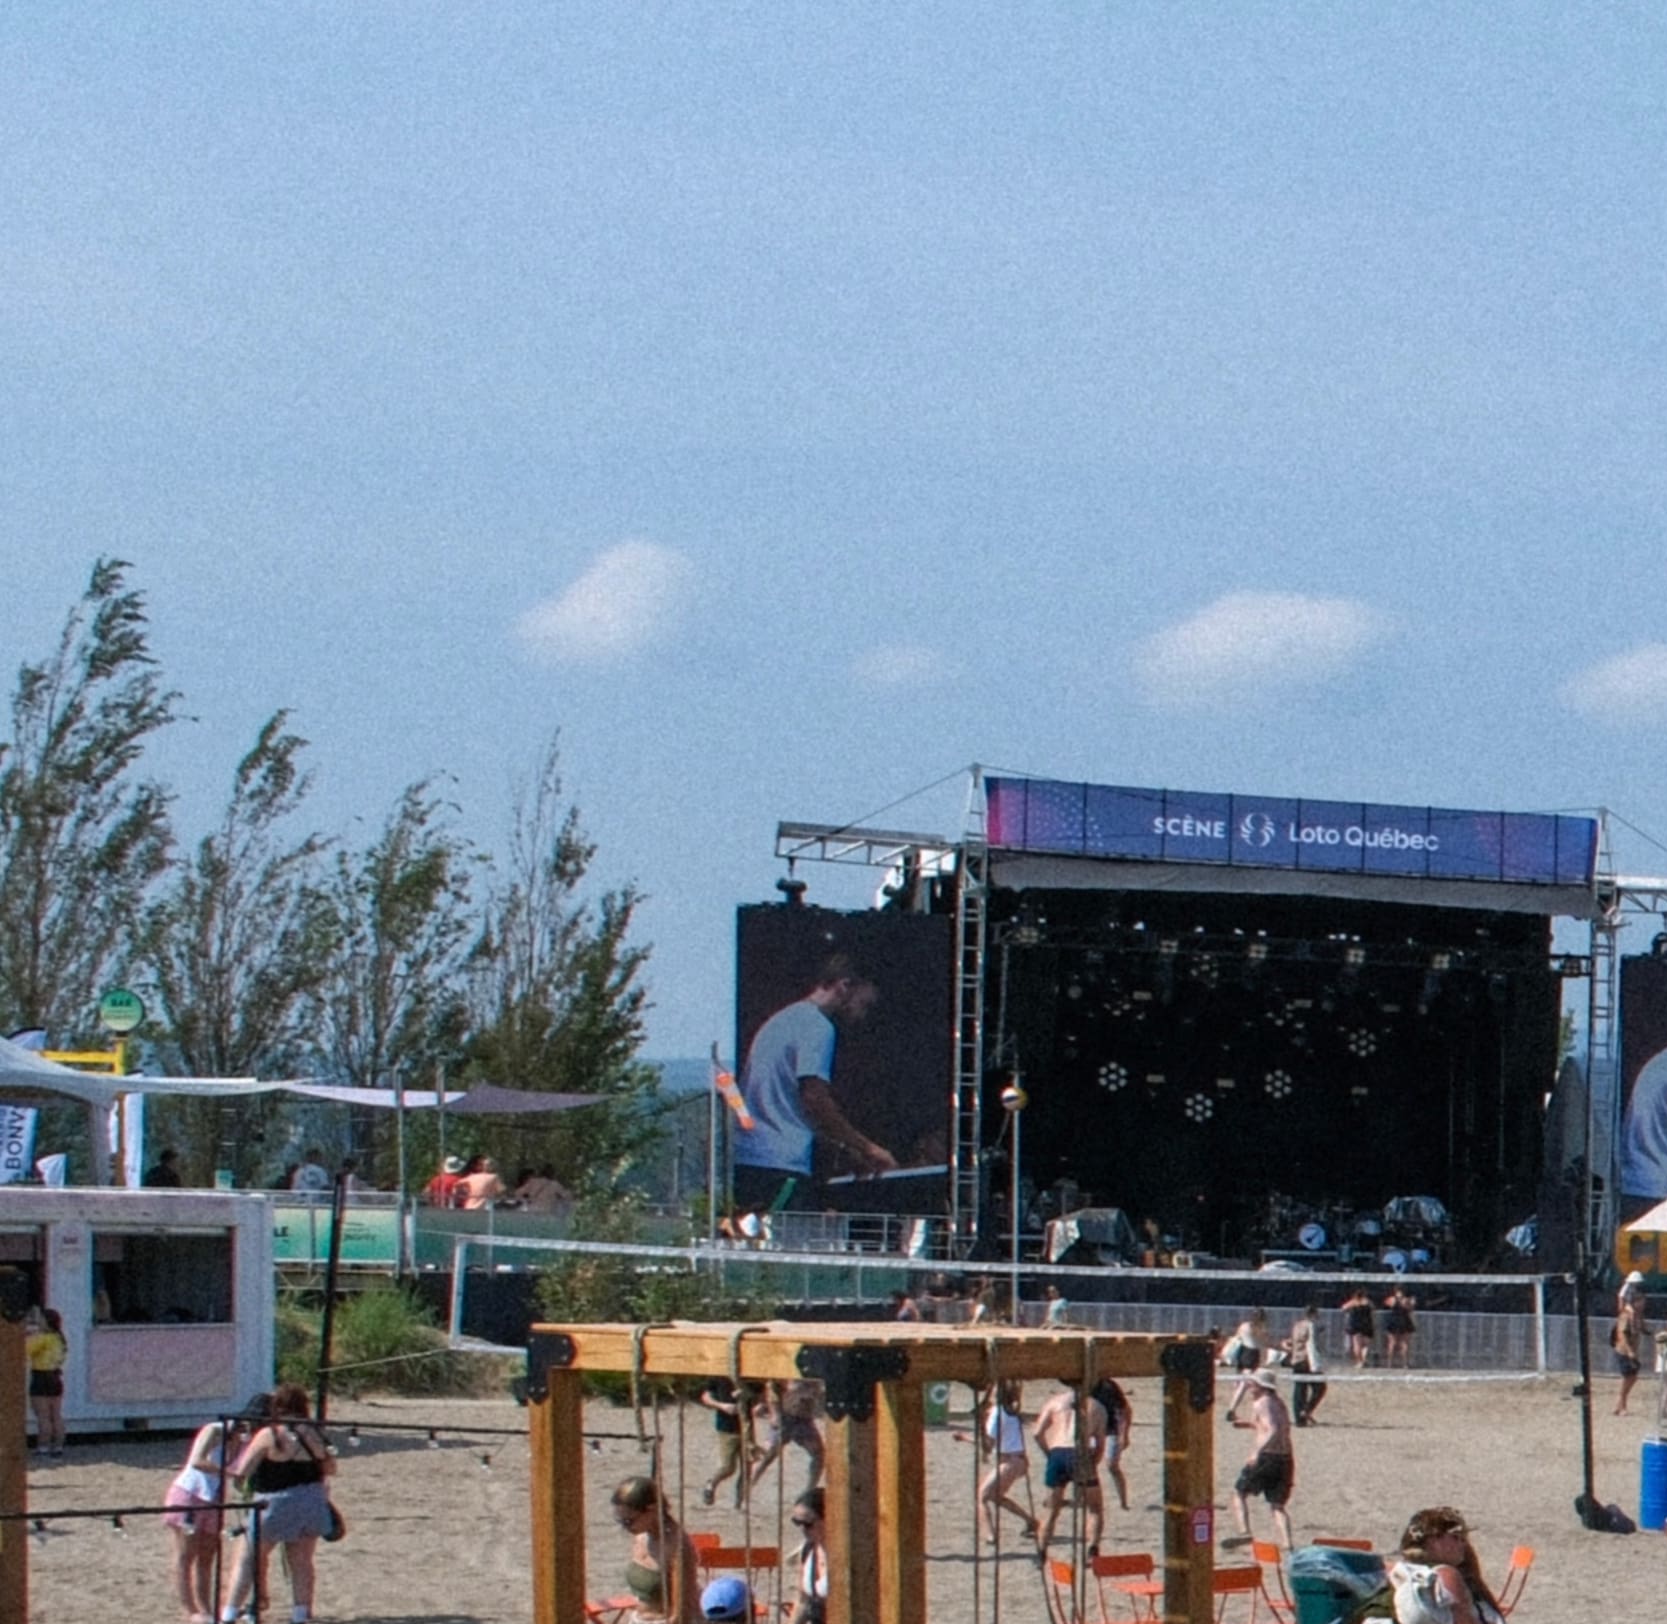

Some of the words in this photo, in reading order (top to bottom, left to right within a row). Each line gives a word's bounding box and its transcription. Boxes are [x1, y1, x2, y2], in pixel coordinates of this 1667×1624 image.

[1153, 815, 1226, 839] SCÈNE
[1288, 822, 1341, 845] Loto
[1344, 826, 1440, 851] Québec
